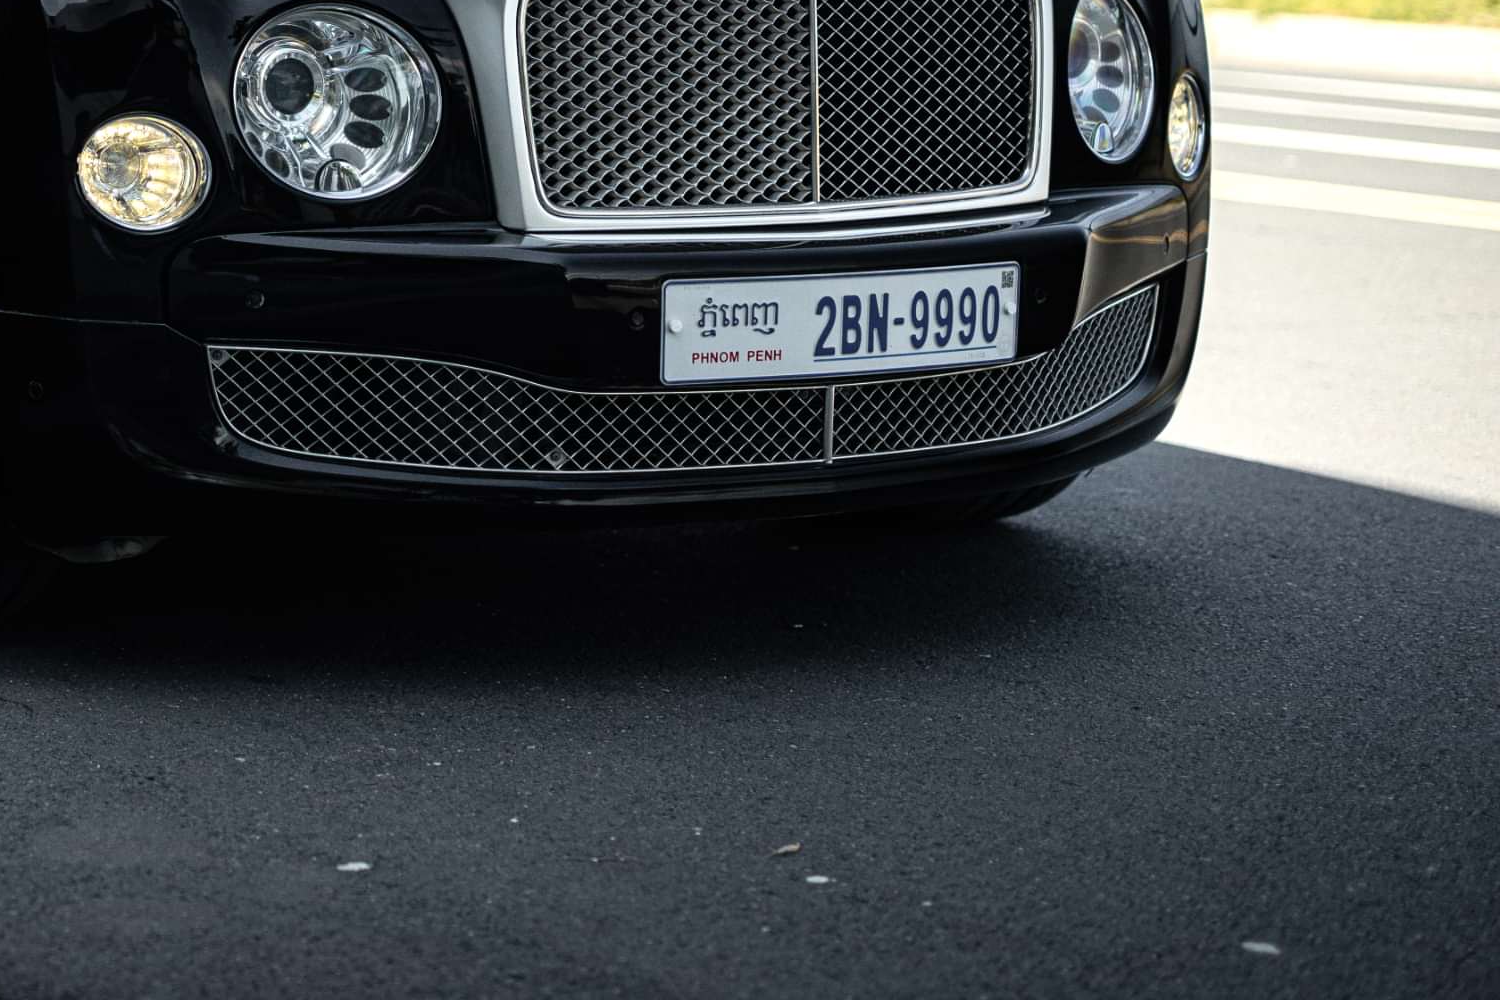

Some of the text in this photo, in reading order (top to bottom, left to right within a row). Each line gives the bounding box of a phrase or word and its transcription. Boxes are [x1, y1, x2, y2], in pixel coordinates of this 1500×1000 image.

[697, 297, 780, 338] ភ្នំពេញ
[813, 285, 1000, 357] 2BN-9990
[691, 349, 783, 365] PHNOM PENH
